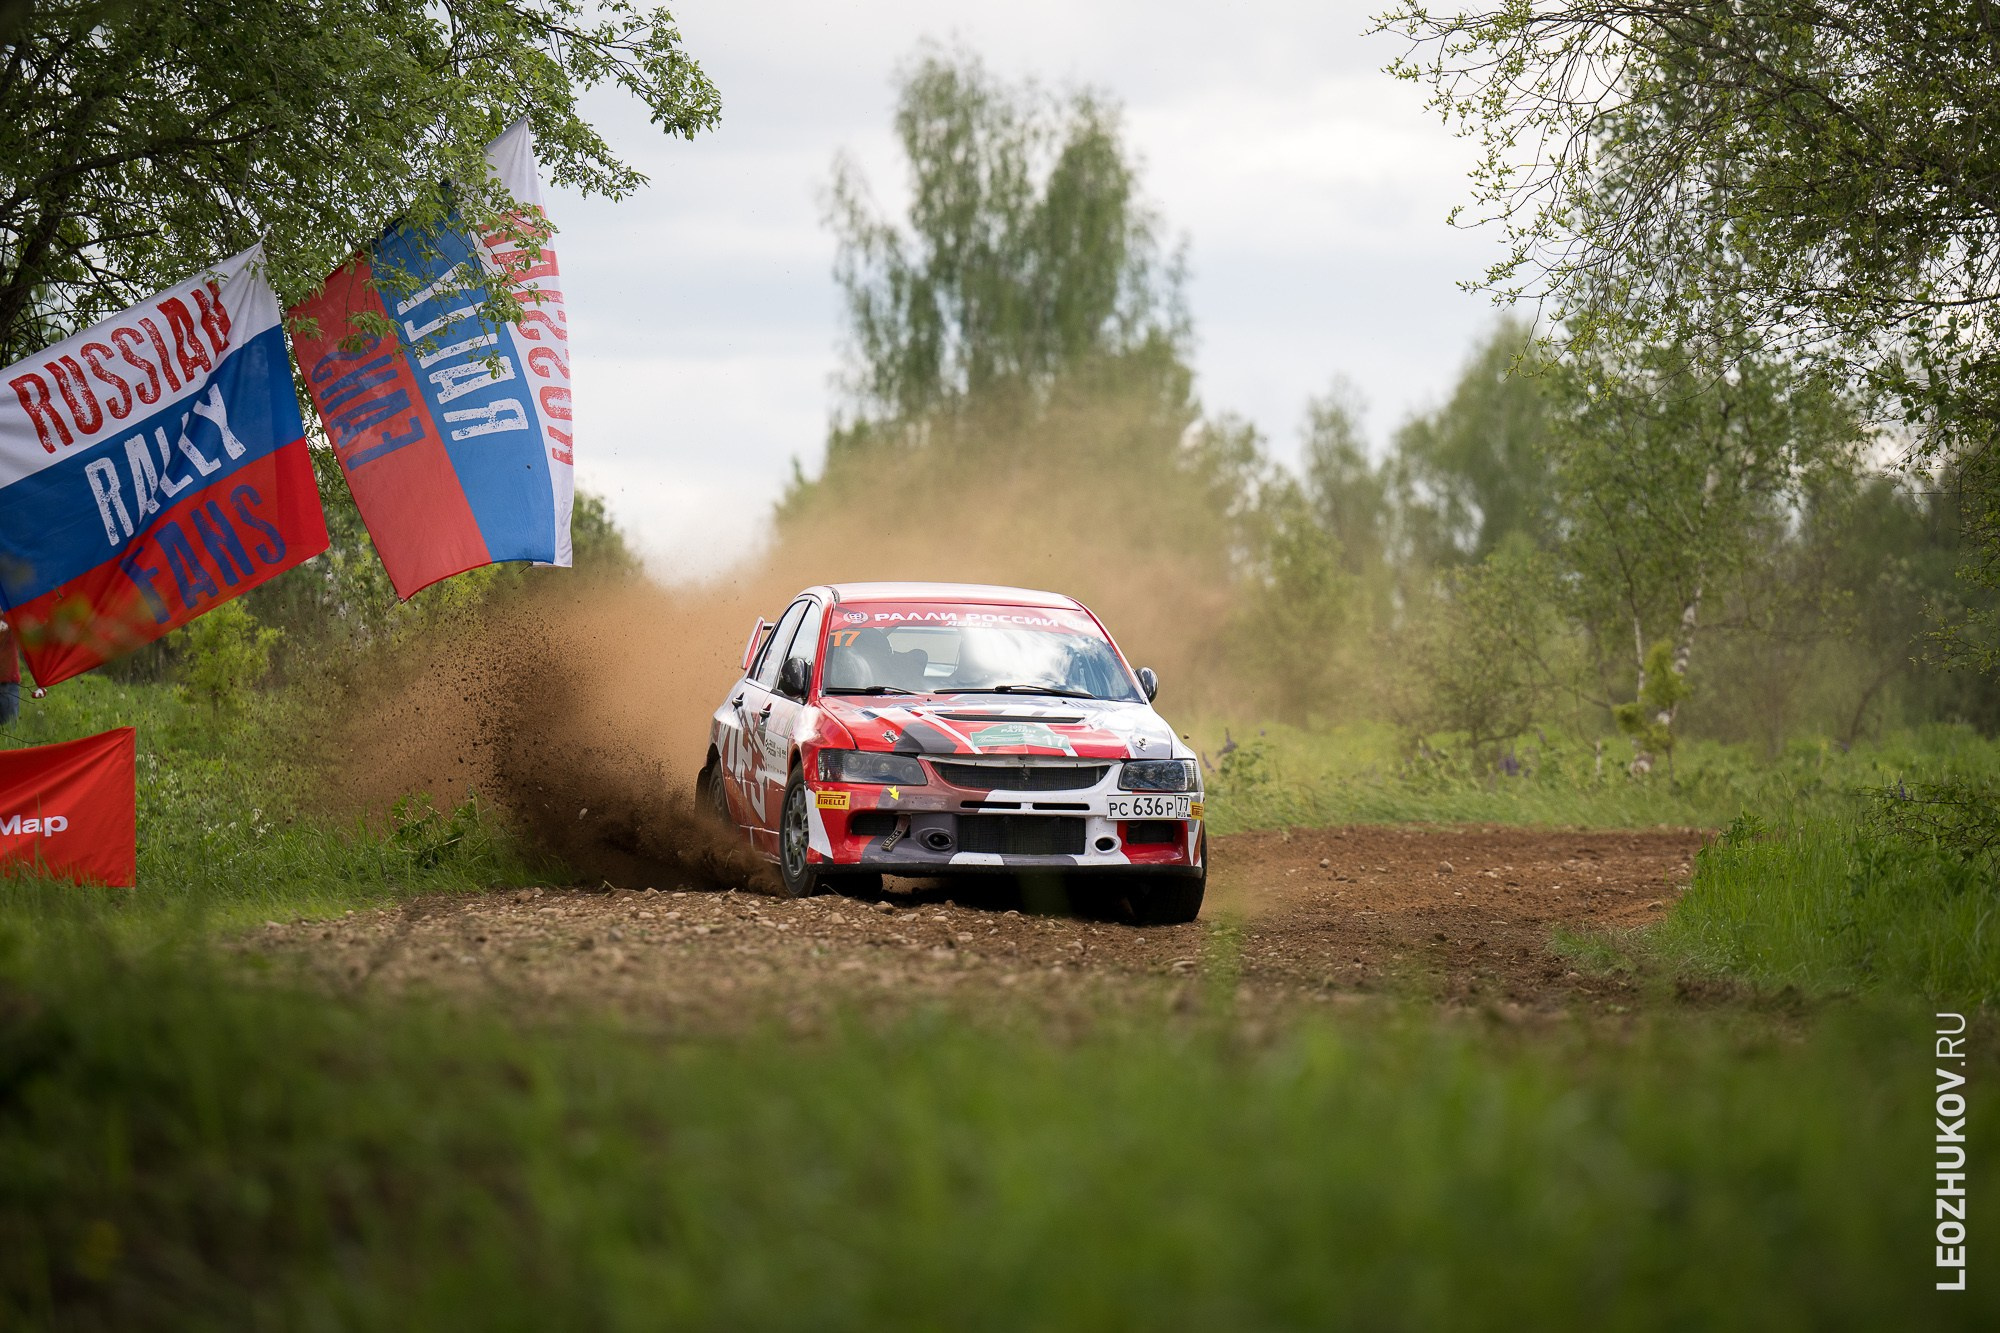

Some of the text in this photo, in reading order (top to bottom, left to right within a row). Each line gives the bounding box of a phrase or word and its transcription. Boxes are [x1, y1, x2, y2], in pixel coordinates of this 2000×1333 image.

[9, 280, 232, 453] RUSSIAN
[85, 384, 246, 545] RALLY
[121, 485, 286, 624] FANS
[874, 612, 958, 622] РАЛЛИ
[965, 613, 1059, 627] РОССИИ
[830, 630, 861, 647] 17
[1042, 735, 1066, 747] 17
[817, 794, 847, 806] PIRELLI
[1177, 797, 1189, 811] 77
